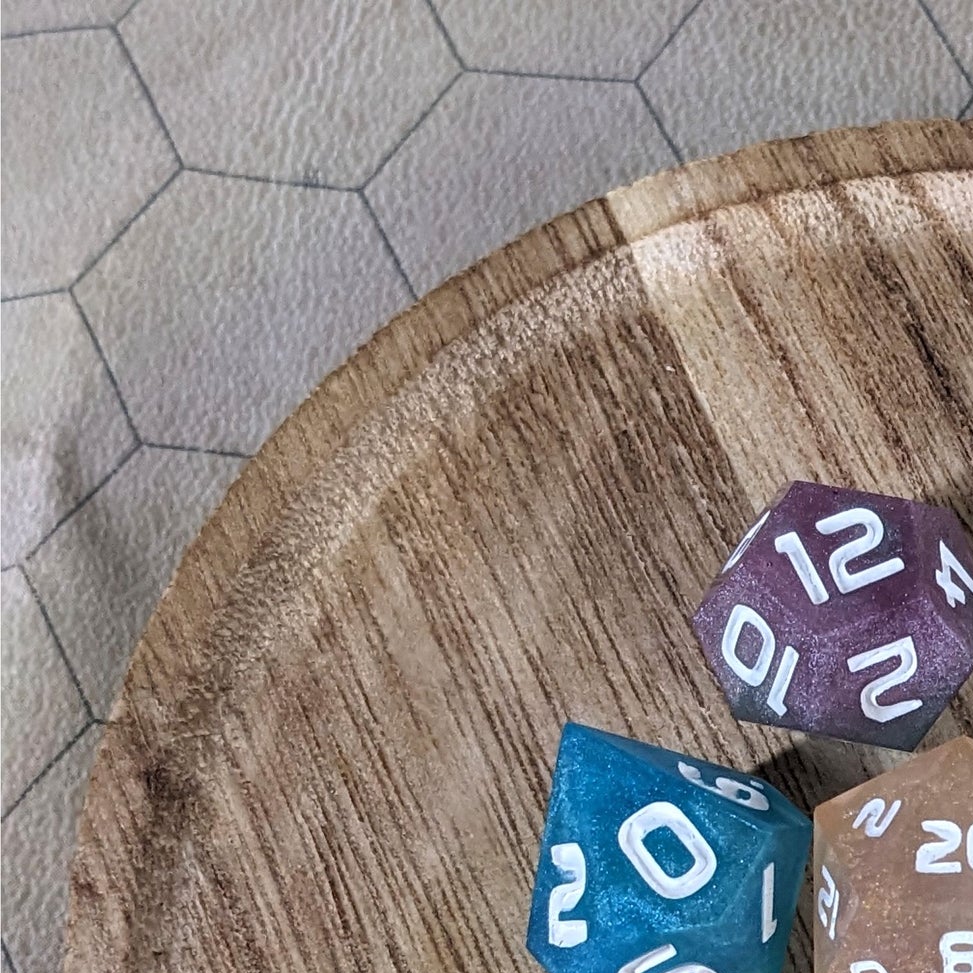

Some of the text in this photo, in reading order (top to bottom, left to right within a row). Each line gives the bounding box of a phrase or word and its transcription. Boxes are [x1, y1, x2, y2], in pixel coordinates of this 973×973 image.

[775, 507, 905, 605] 12
[721, 603, 800, 717] 10
[847, 635, 924, 723] 2
[617, 801, 718, 900] 0
[852, 798, 902, 838] 2
[548, 842, 588, 949] 2
[761, 862, 778, 944] 1
